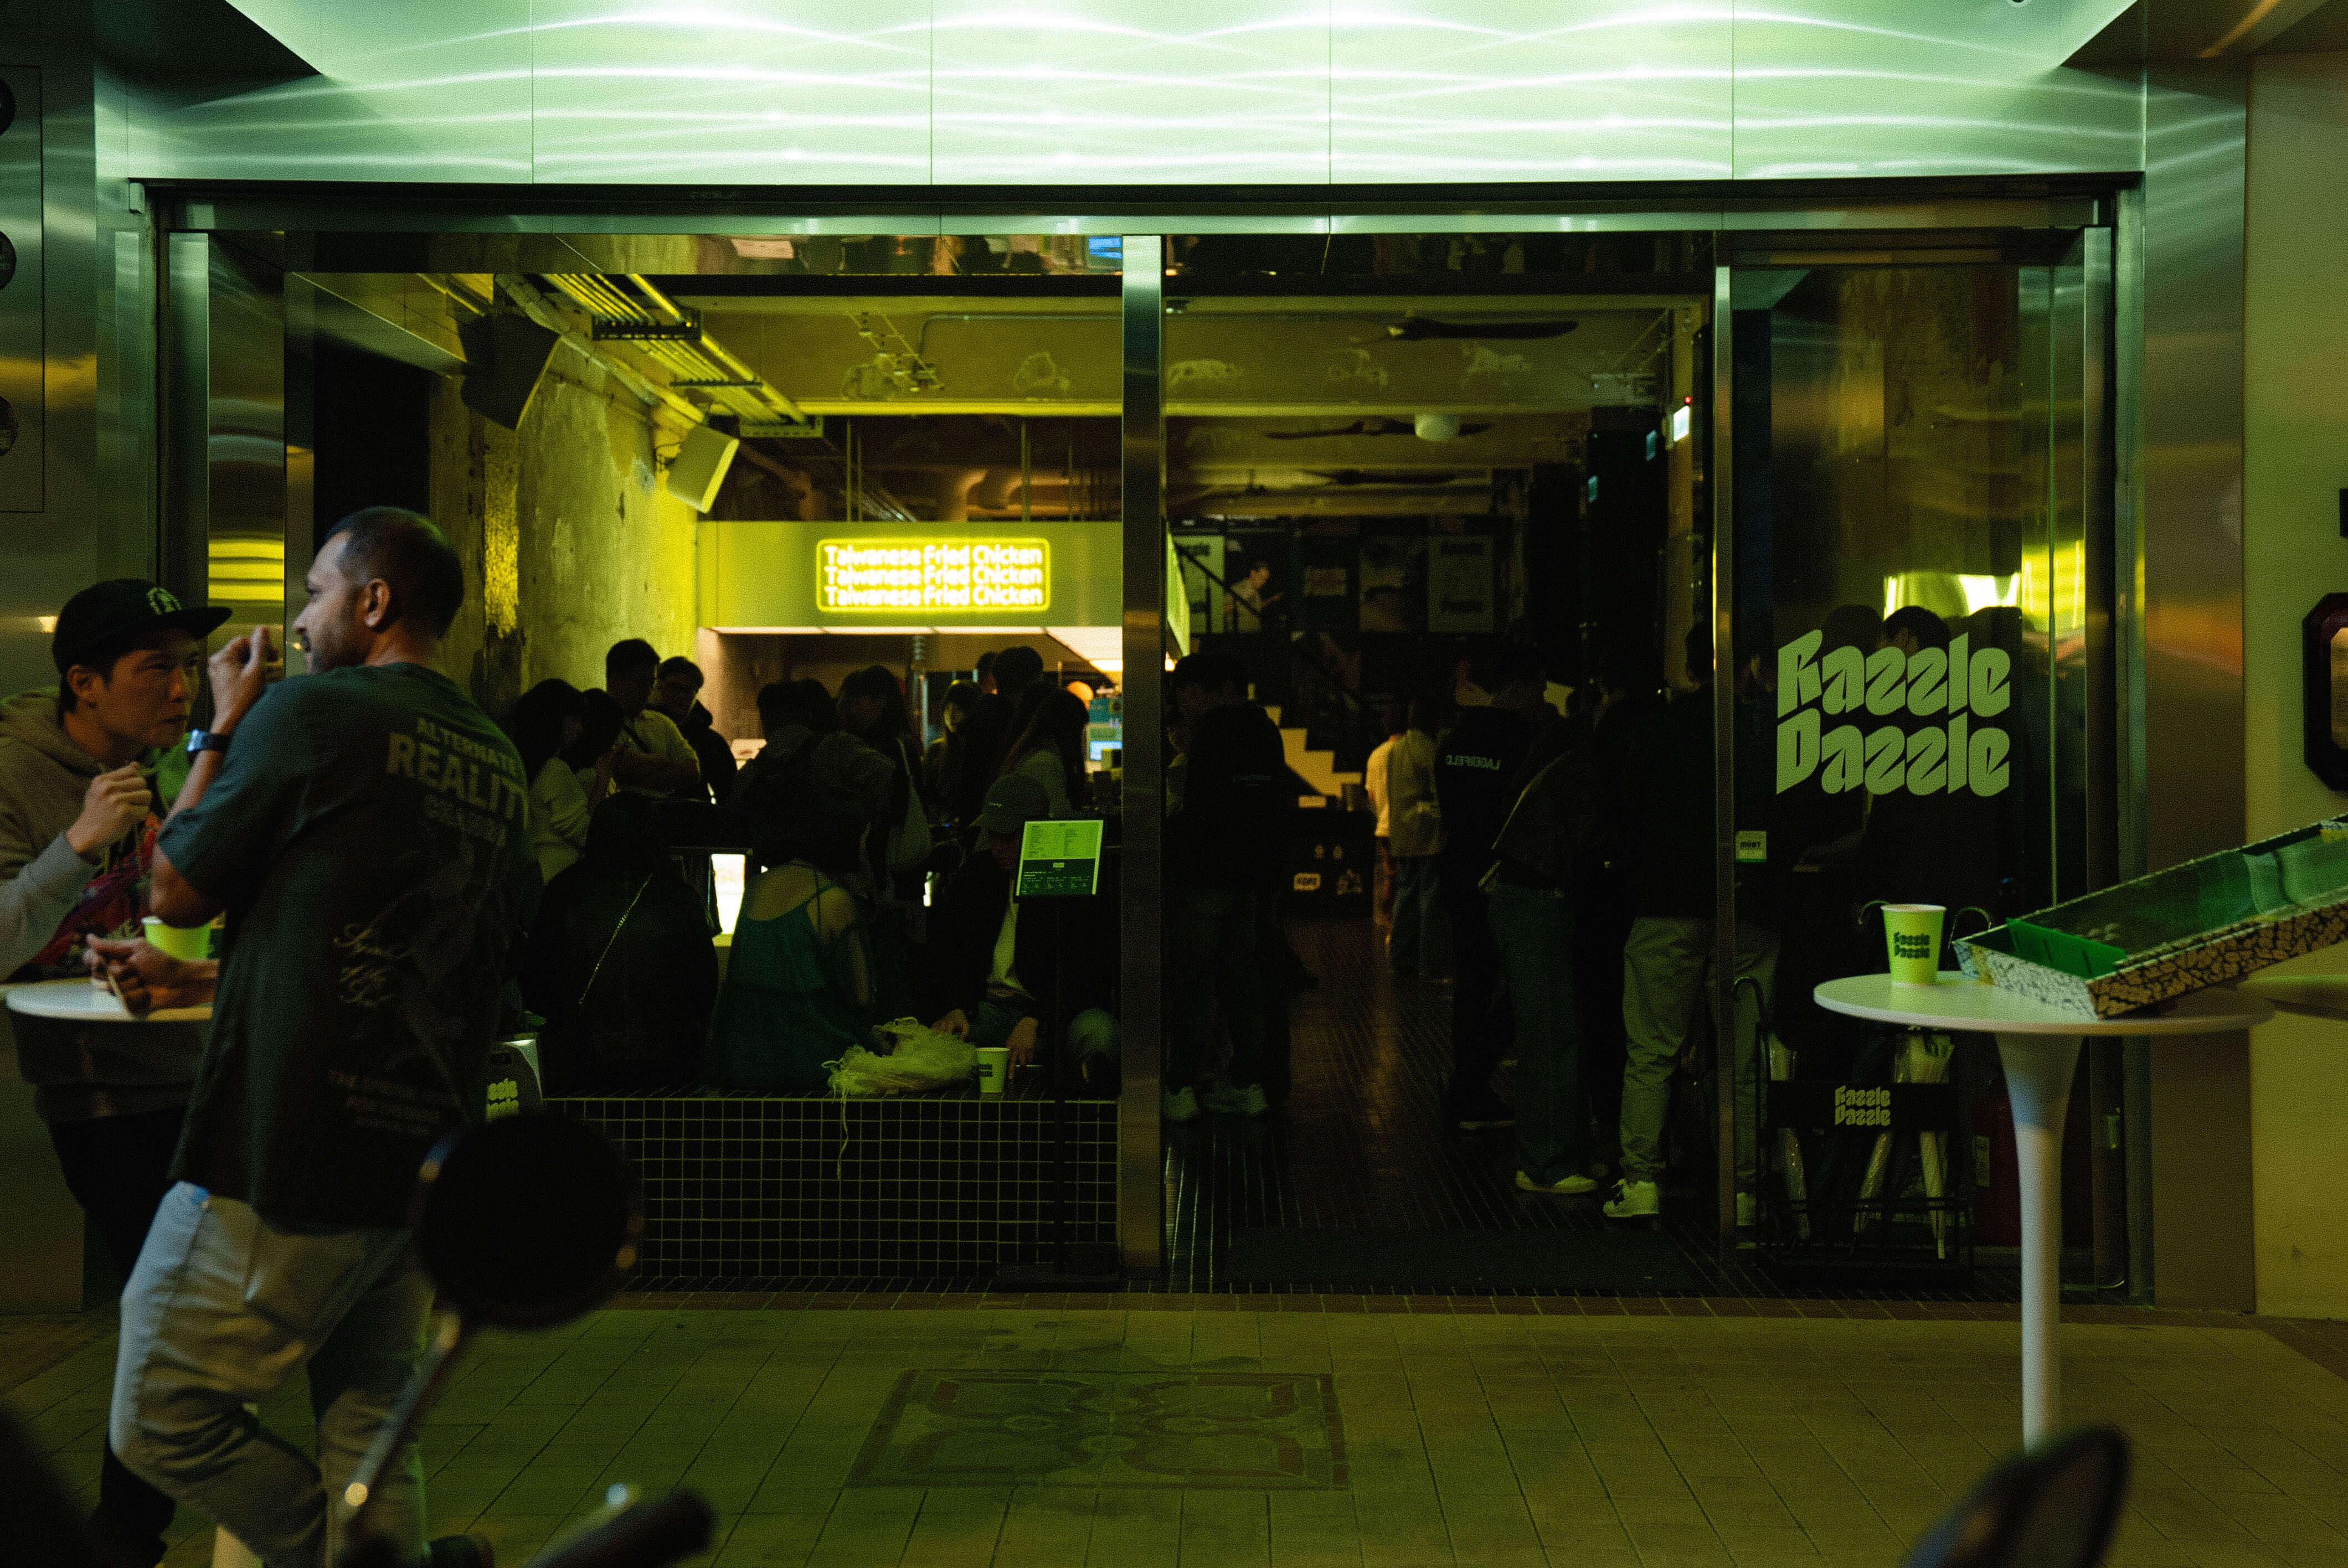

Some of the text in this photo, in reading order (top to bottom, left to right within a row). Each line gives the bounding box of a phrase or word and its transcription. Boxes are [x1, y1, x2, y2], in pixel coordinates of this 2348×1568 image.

[825, 544, 1043, 566] Taiwanese Fried Chicken
[825, 564, 1043, 585] Taiwanese Fried Chicken
[825, 585, 1043, 606] Taiwanese Fried Chicken
[1777, 629, 2011, 719] Razzle
[1776, 708, 2010, 797] Dazzle
[1834, 1085, 1891, 1107] Razzle
[1834, 1104, 1891, 1127] Dazzle
